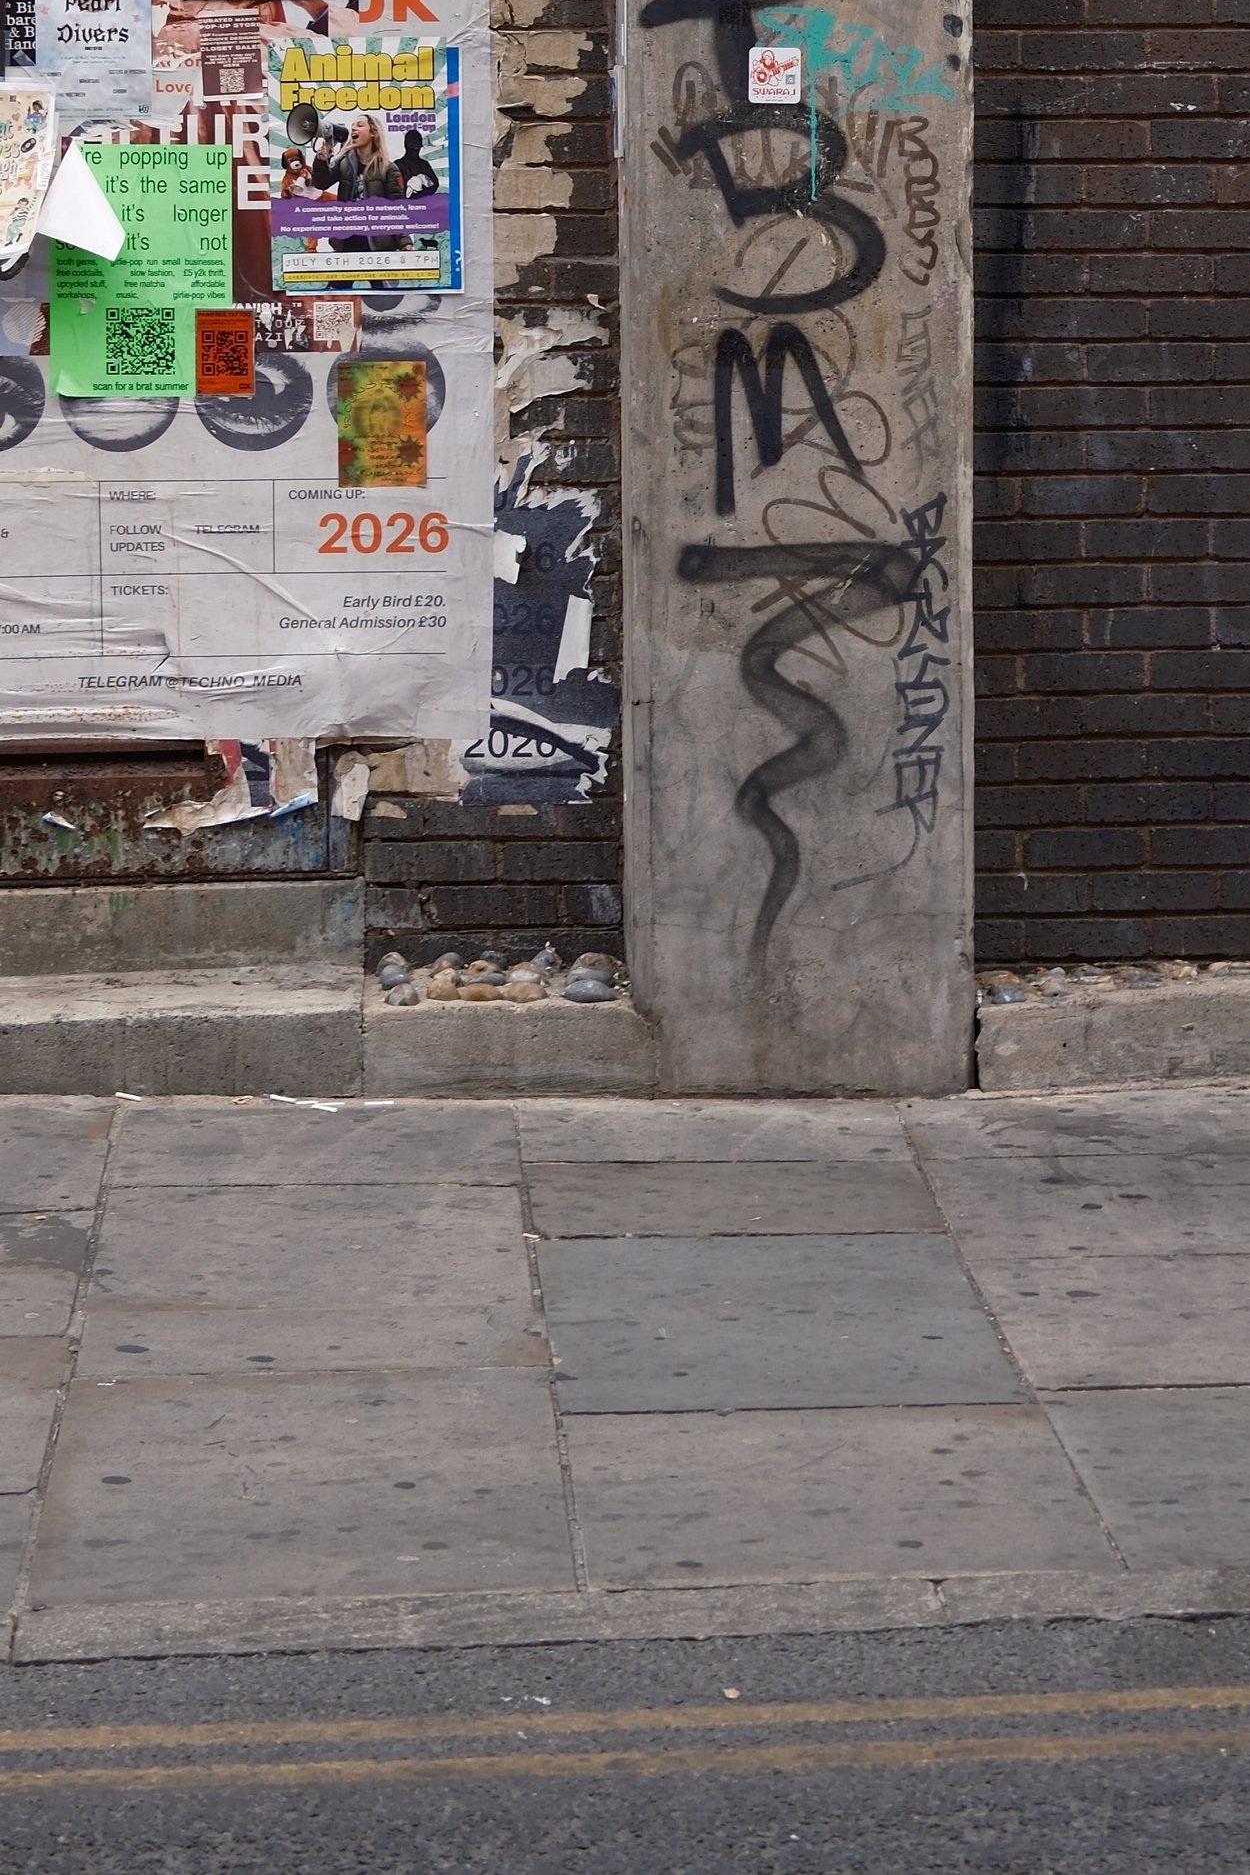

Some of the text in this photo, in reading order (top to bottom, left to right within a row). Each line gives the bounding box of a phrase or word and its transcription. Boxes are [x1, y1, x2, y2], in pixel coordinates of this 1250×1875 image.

[56, 23, 130, 43] Divers
[280, 44, 436, 83] Animal
[279, 79, 437, 112] Freedom
[386, 111, 437, 123] London
[119, 147, 228, 170] popping up
[105, 175, 227, 194] it's the same
[121, 203, 228, 226] it's longer
[294, 206, 302, 214] A
[302, 205, 343, 215] community
[343, 205, 364, 214] space
[366, 205, 375, 213] to
[375, 204, 407, 213] network,
[311, 215, 326, 223] and
[344, 214, 368, 222] action
[369, 214, 380, 222] for
[380, 213, 410, 221] animals.
[280, 222, 440, 233] No experience necessary, everyone welcome!
[126, 232, 228, 251] it's not
[57, 257, 76, 266] tooth
[76, 259, 98, 268] gems,
[161, 257, 181, 266] small
[184, 257, 226, 267] businesses,
[284, 257, 317, 268] JULY
[325, 256, 350, 267] 6TH
[359, 255, 392, 266] 2026
[56, 268, 226, 279] free cocktails, slow fashion, £5 y2k thrift,
[56, 279, 226, 290] upcycled stuff, free matcha affordable
[56, 290, 226, 300] workshops, music, girlie-pop vibes
[93, 381, 190, 391] scan for a brat summer
[109, 490, 157, 502] WHERE:
[287, 489, 367, 501] COMING UP:
[109, 523, 261, 537] FOLLOW TELEGRAM
[317, 512, 450, 555] 2026
[109, 540, 166, 553] UPDATES
[111, 584, 169, 597] TICKETS:
[343, 594, 447, 610] Early Bird £20.
[20, 623, 41, 634] AM
[278, 615, 447, 630] General Admission £30
[78, 674, 302, 689] TELEGRAM @TECHNO_MEDIA
